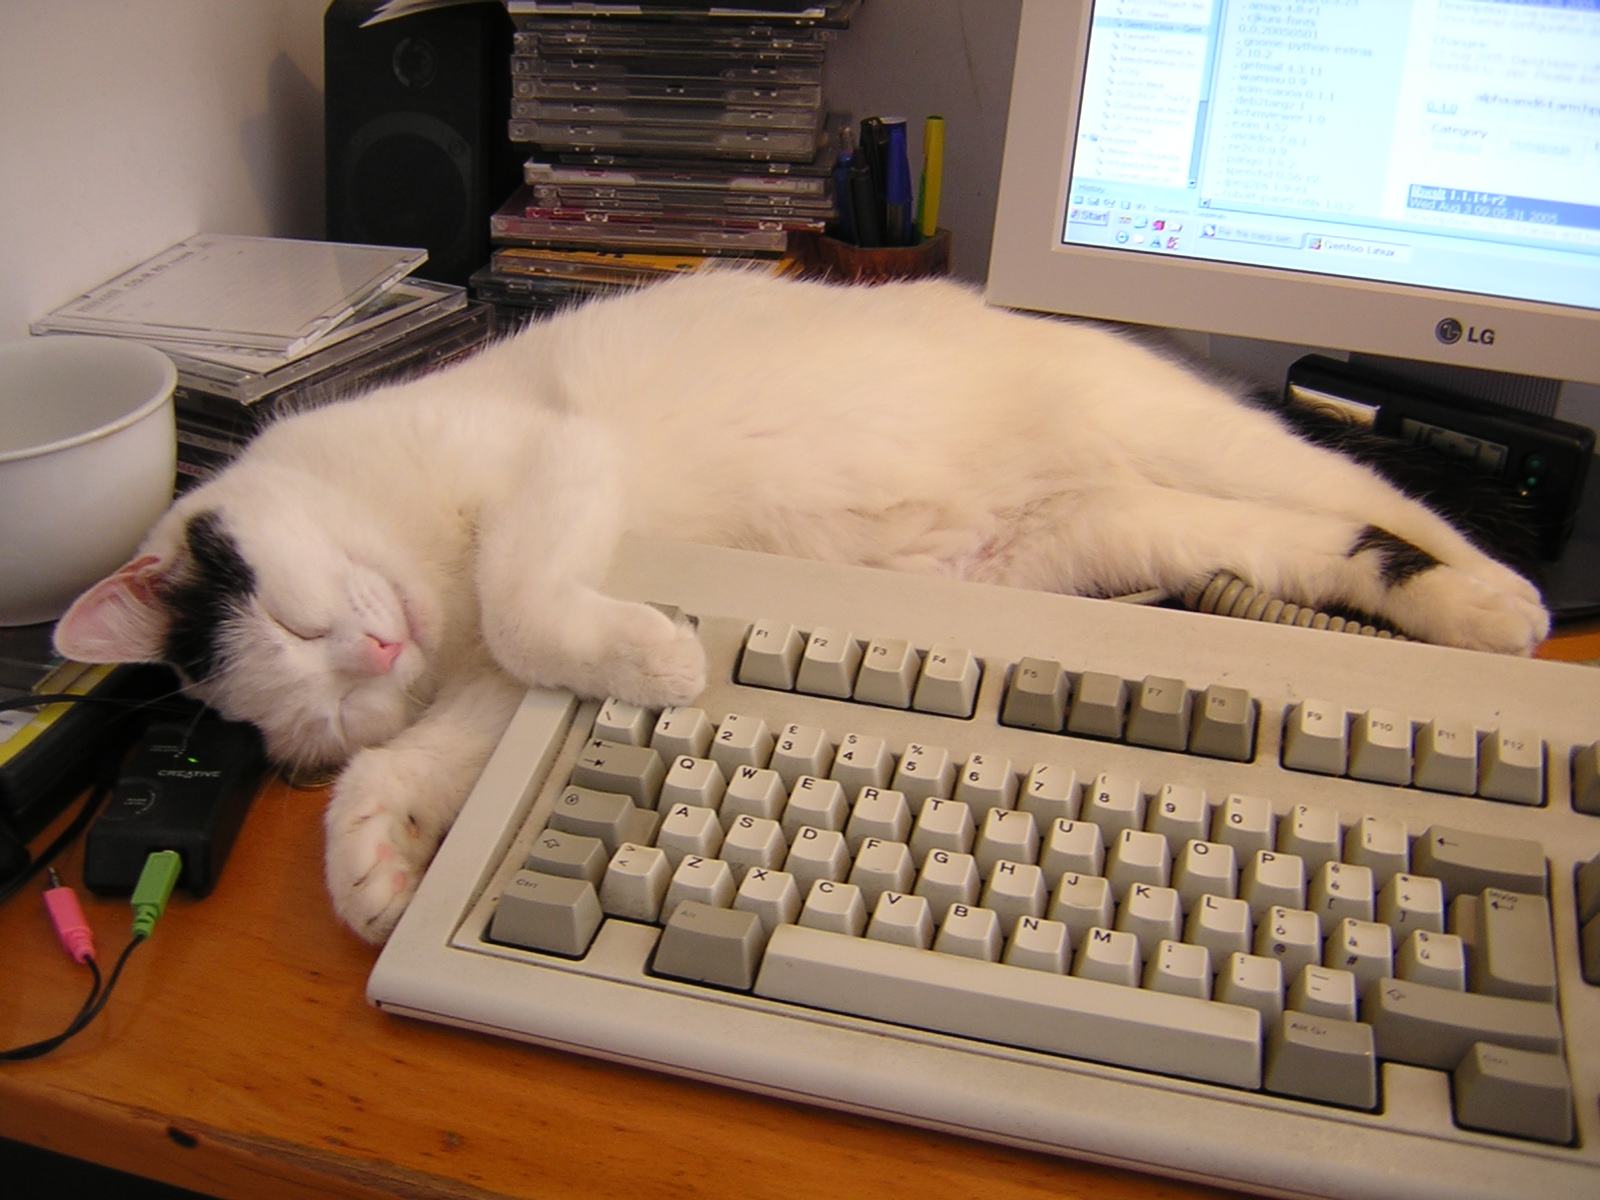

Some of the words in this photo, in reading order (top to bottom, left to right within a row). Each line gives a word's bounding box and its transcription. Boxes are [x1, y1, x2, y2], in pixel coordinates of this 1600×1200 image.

[1240, 61, 1283, 73] getmail
[1430, 122, 1489, 140] Category
[1438, 201, 1462, 214] Aug
[1082, 210, 1107, 221] Start
[1323, 239, 1363, 253] Gentoo
[1367, 246, 1396, 258] Linux
[1467, 326, 1495, 346] LG
[756, 629, 768, 638] F1
[814, 638, 828, 647] F2
[873, 646, 887, 656] F3
[933, 655, 946, 664] F4
[1024, 669, 1038, 678] F5
[1148, 687, 1163, 696] F7
[1308, 711, 1323, 721] F9
[1371, 721, 1394, 732] F10
[721, 731, 733, 741] 2
[1438, 730, 1456, 740] F11
[782, 741, 793, 751] 3
[1503, 739, 1525, 750] F12
[843, 752, 853, 760] 4
[680, 758, 695, 770] Q
[906, 761, 916, 771] 5
[158, 770, 222, 779] CREATIVE
[742, 768, 758, 779] W
[969, 772, 979, 782] 6
[801, 778, 815, 790] E
[1035, 782, 1044, 791] 7
[865, 788, 879, 801] R
[1099, 793, 1110, 803] 8
[932, 799, 944, 811] T
[1166, 803, 1176, 813] 9
[675, 807, 688, 817] A
[995, 810, 1009, 821] Y
[740, 817, 754, 828] S
[1059, 820, 1074, 833] U
[803, 828, 818, 840] D
[867, 839, 881, 849] F
[1194, 843, 1209, 855] O
[688, 857, 703, 868] Z
[934, 852, 949, 864] G
[1262, 853, 1276, 863] P
[1000, 862, 1015, 875] H
[753, 869, 768, 881] X
[516, 878, 538, 888] Ctrl
[1067, 876, 1079, 886] J
[819, 882, 834, 893] C
[1136, 885, 1150, 898] K
[888, 893, 902, 904] V
[1206, 896, 1218, 910] L
[954, 905, 968, 917] B
[1024, 918, 1039, 931] N
[1095, 930, 1111, 943] M
